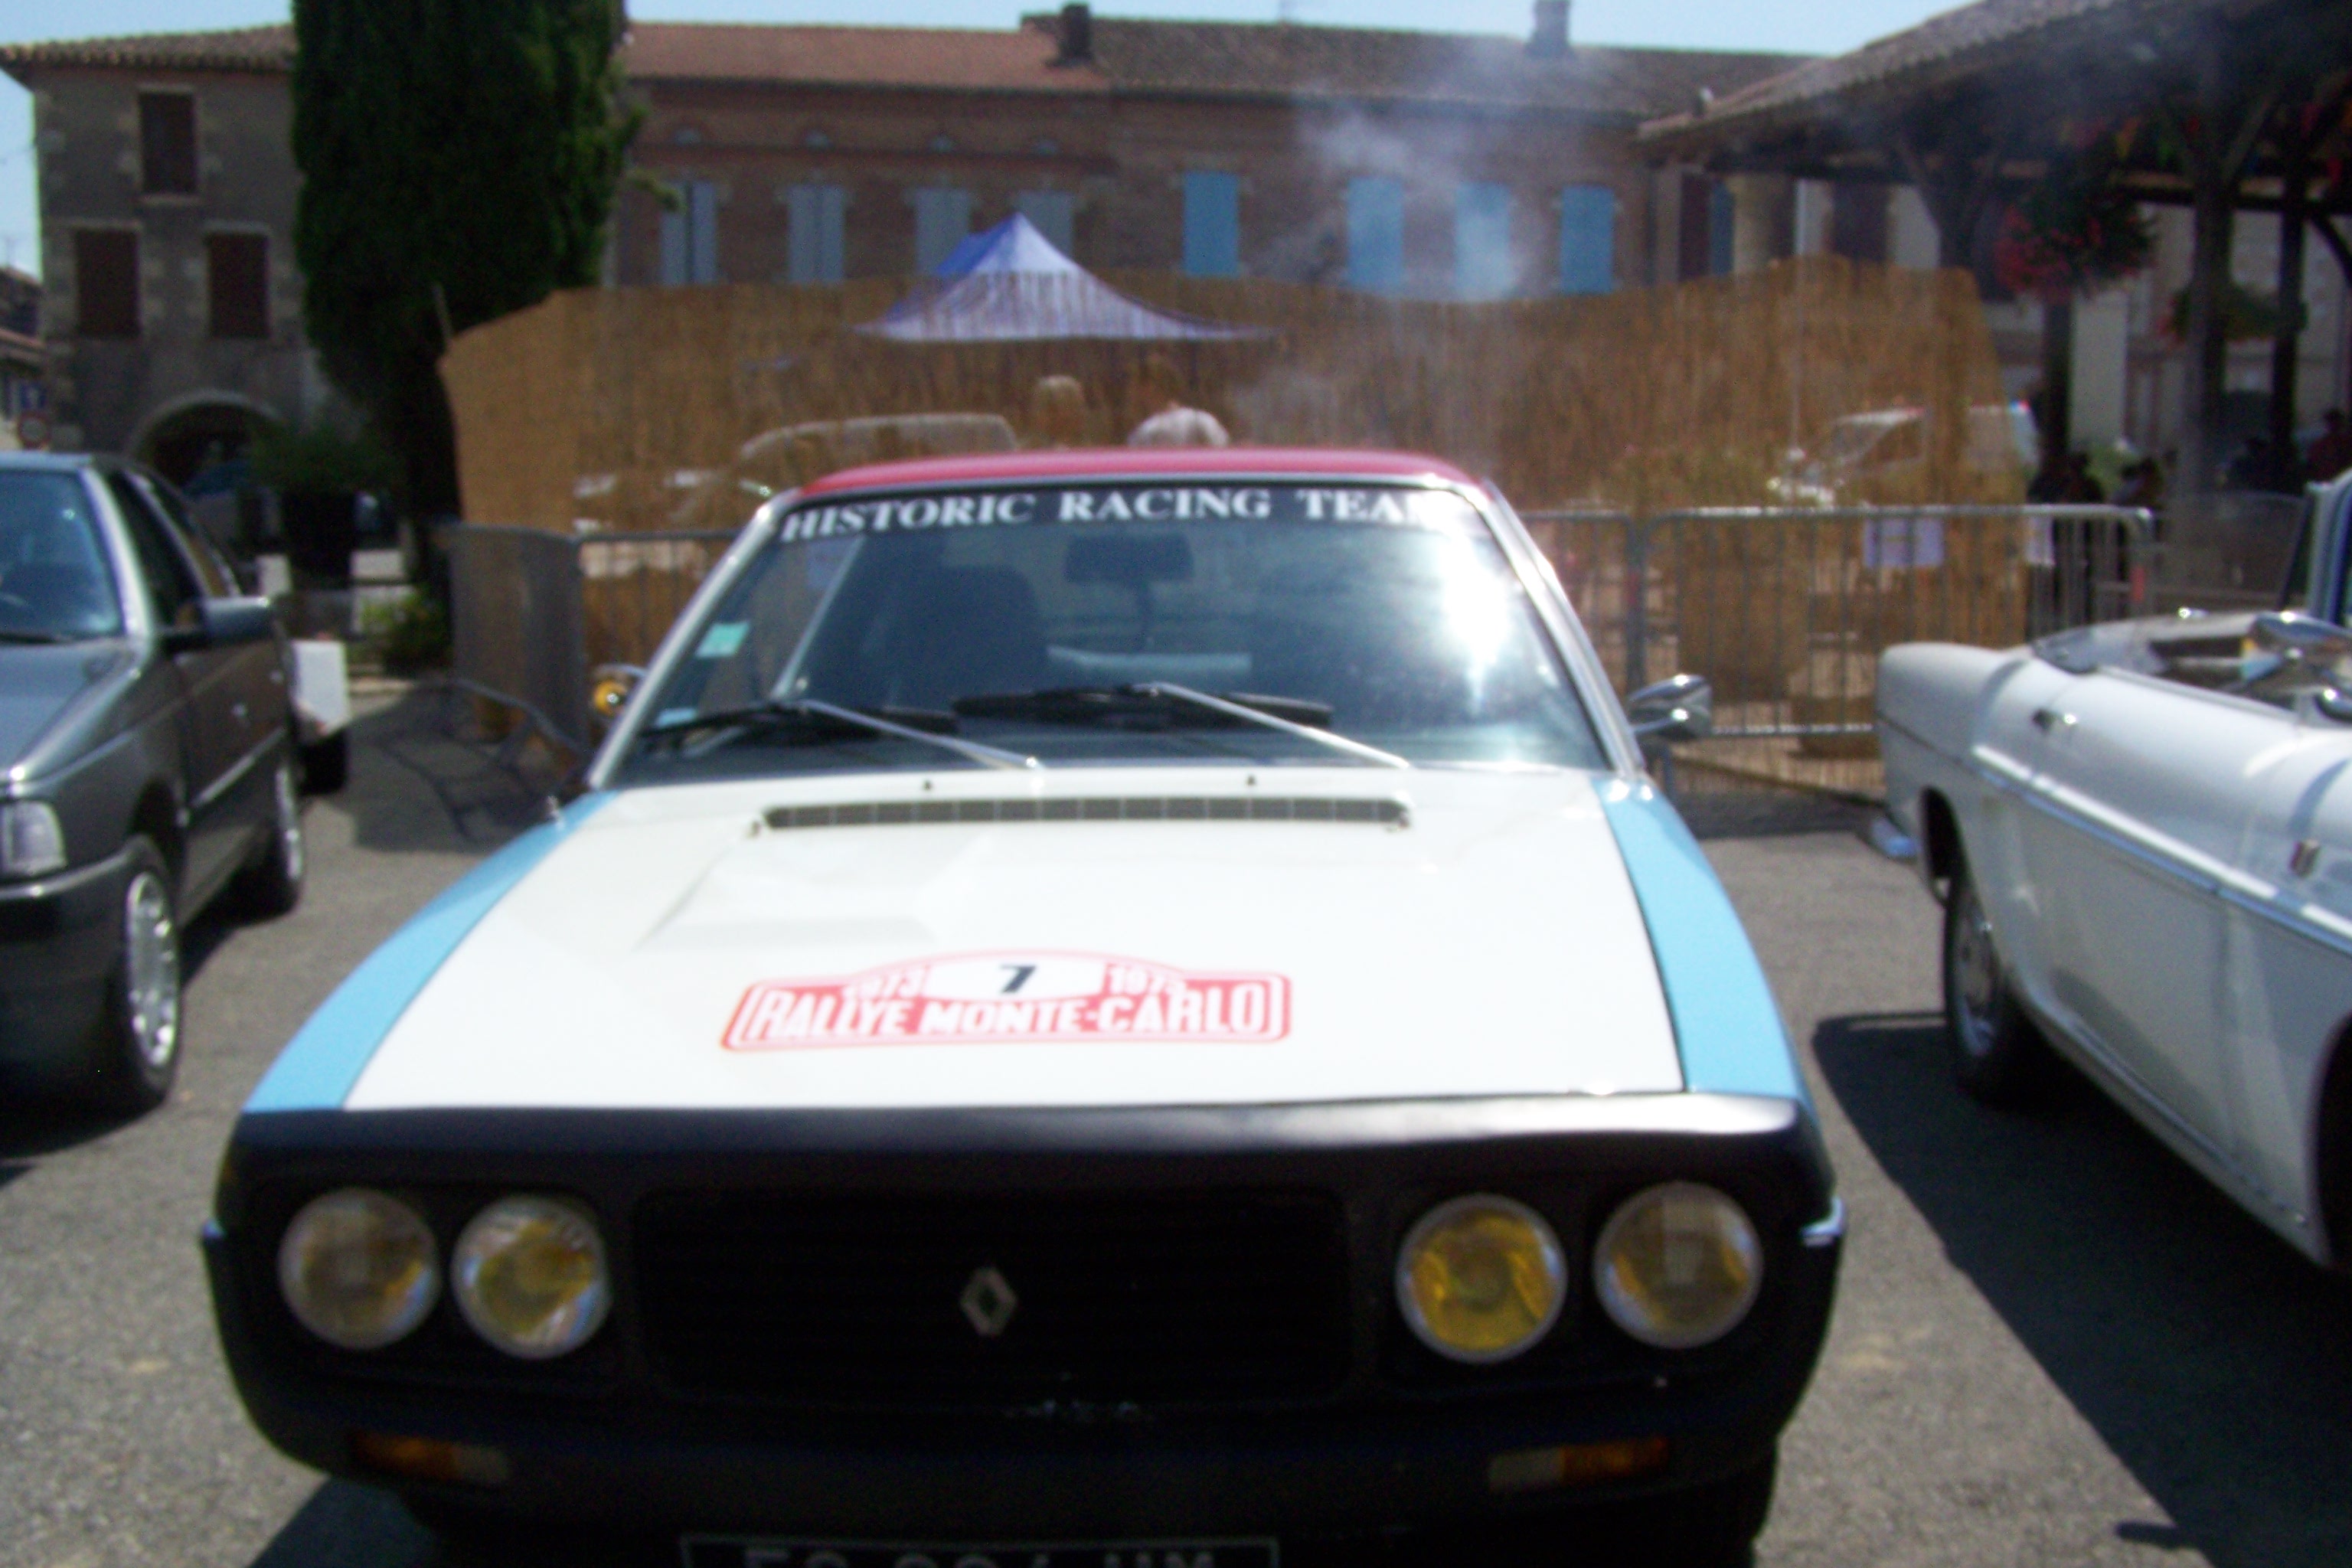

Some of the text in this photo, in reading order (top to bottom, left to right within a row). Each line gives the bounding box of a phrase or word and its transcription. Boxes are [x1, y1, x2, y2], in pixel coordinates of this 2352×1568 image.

[780, 488, 1443, 543] HISTORIC RACING TEA
[1000, 965, 1037, 994] 7
[756, 984, 1266, 1038] RALLYE MONTE-CARLO
